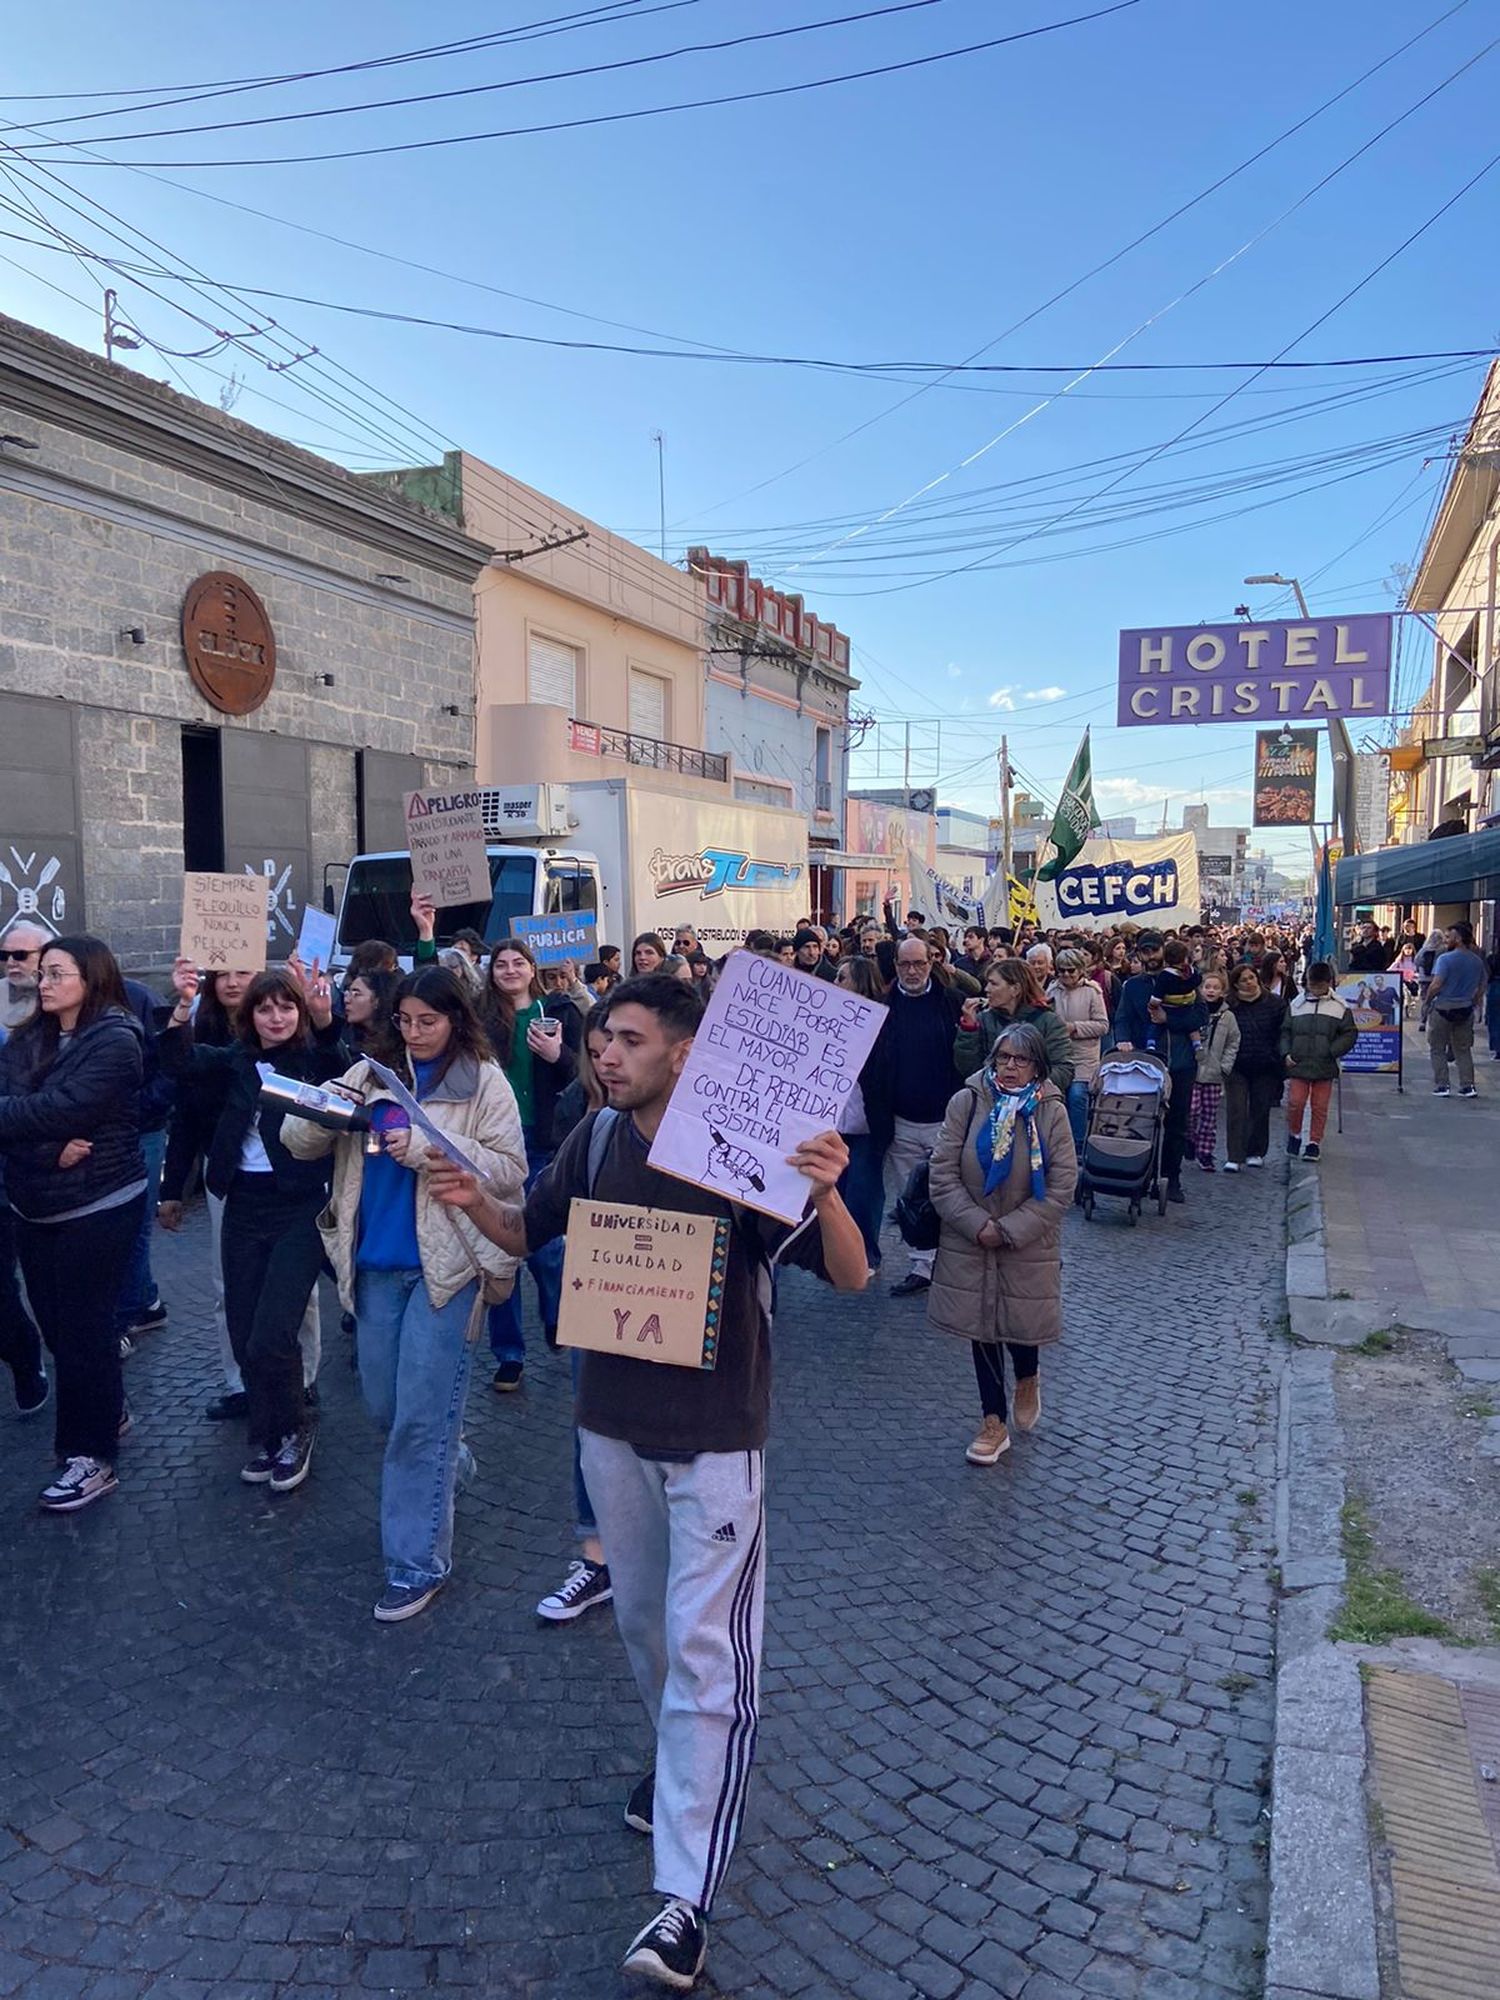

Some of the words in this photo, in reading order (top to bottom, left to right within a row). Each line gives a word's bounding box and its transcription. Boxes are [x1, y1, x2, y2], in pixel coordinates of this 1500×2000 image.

[1139, 626, 1368, 673] HOTEL
[1131, 677, 1375, 718] CRISTAL
[195, 878, 256, 892] SIEMPRE
[1059, 874, 1175, 907] CEFCH
[748, 959, 827, 1009] CUANDO
[840, 1000, 872, 1029] SE
[733, 983, 781, 1014] NACE
[795, 1006, 849, 1044] POBRE
[707, 1024, 730, 1049] EL
[739, 1037, 799, 1074] MAYOR
[821, 1043, 848, 1068] ES
[735, 1063, 765, 1094] DE
[805, 1065, 853, 1094] ACTO
[694, 1074, 760, 1115] CONTRA
[765, 1101, 784, 1126] EL
[714, 1104, 781, 1147] SISTEMA
[591, 1213, 696, 1236] UNIVERSIDAD
[592, 1249, 683, 1272] IGUALDAD
[587, 1278, 695, 1301] FINANCIAMIENTO
[613, 1308, 664, 1344] YA
